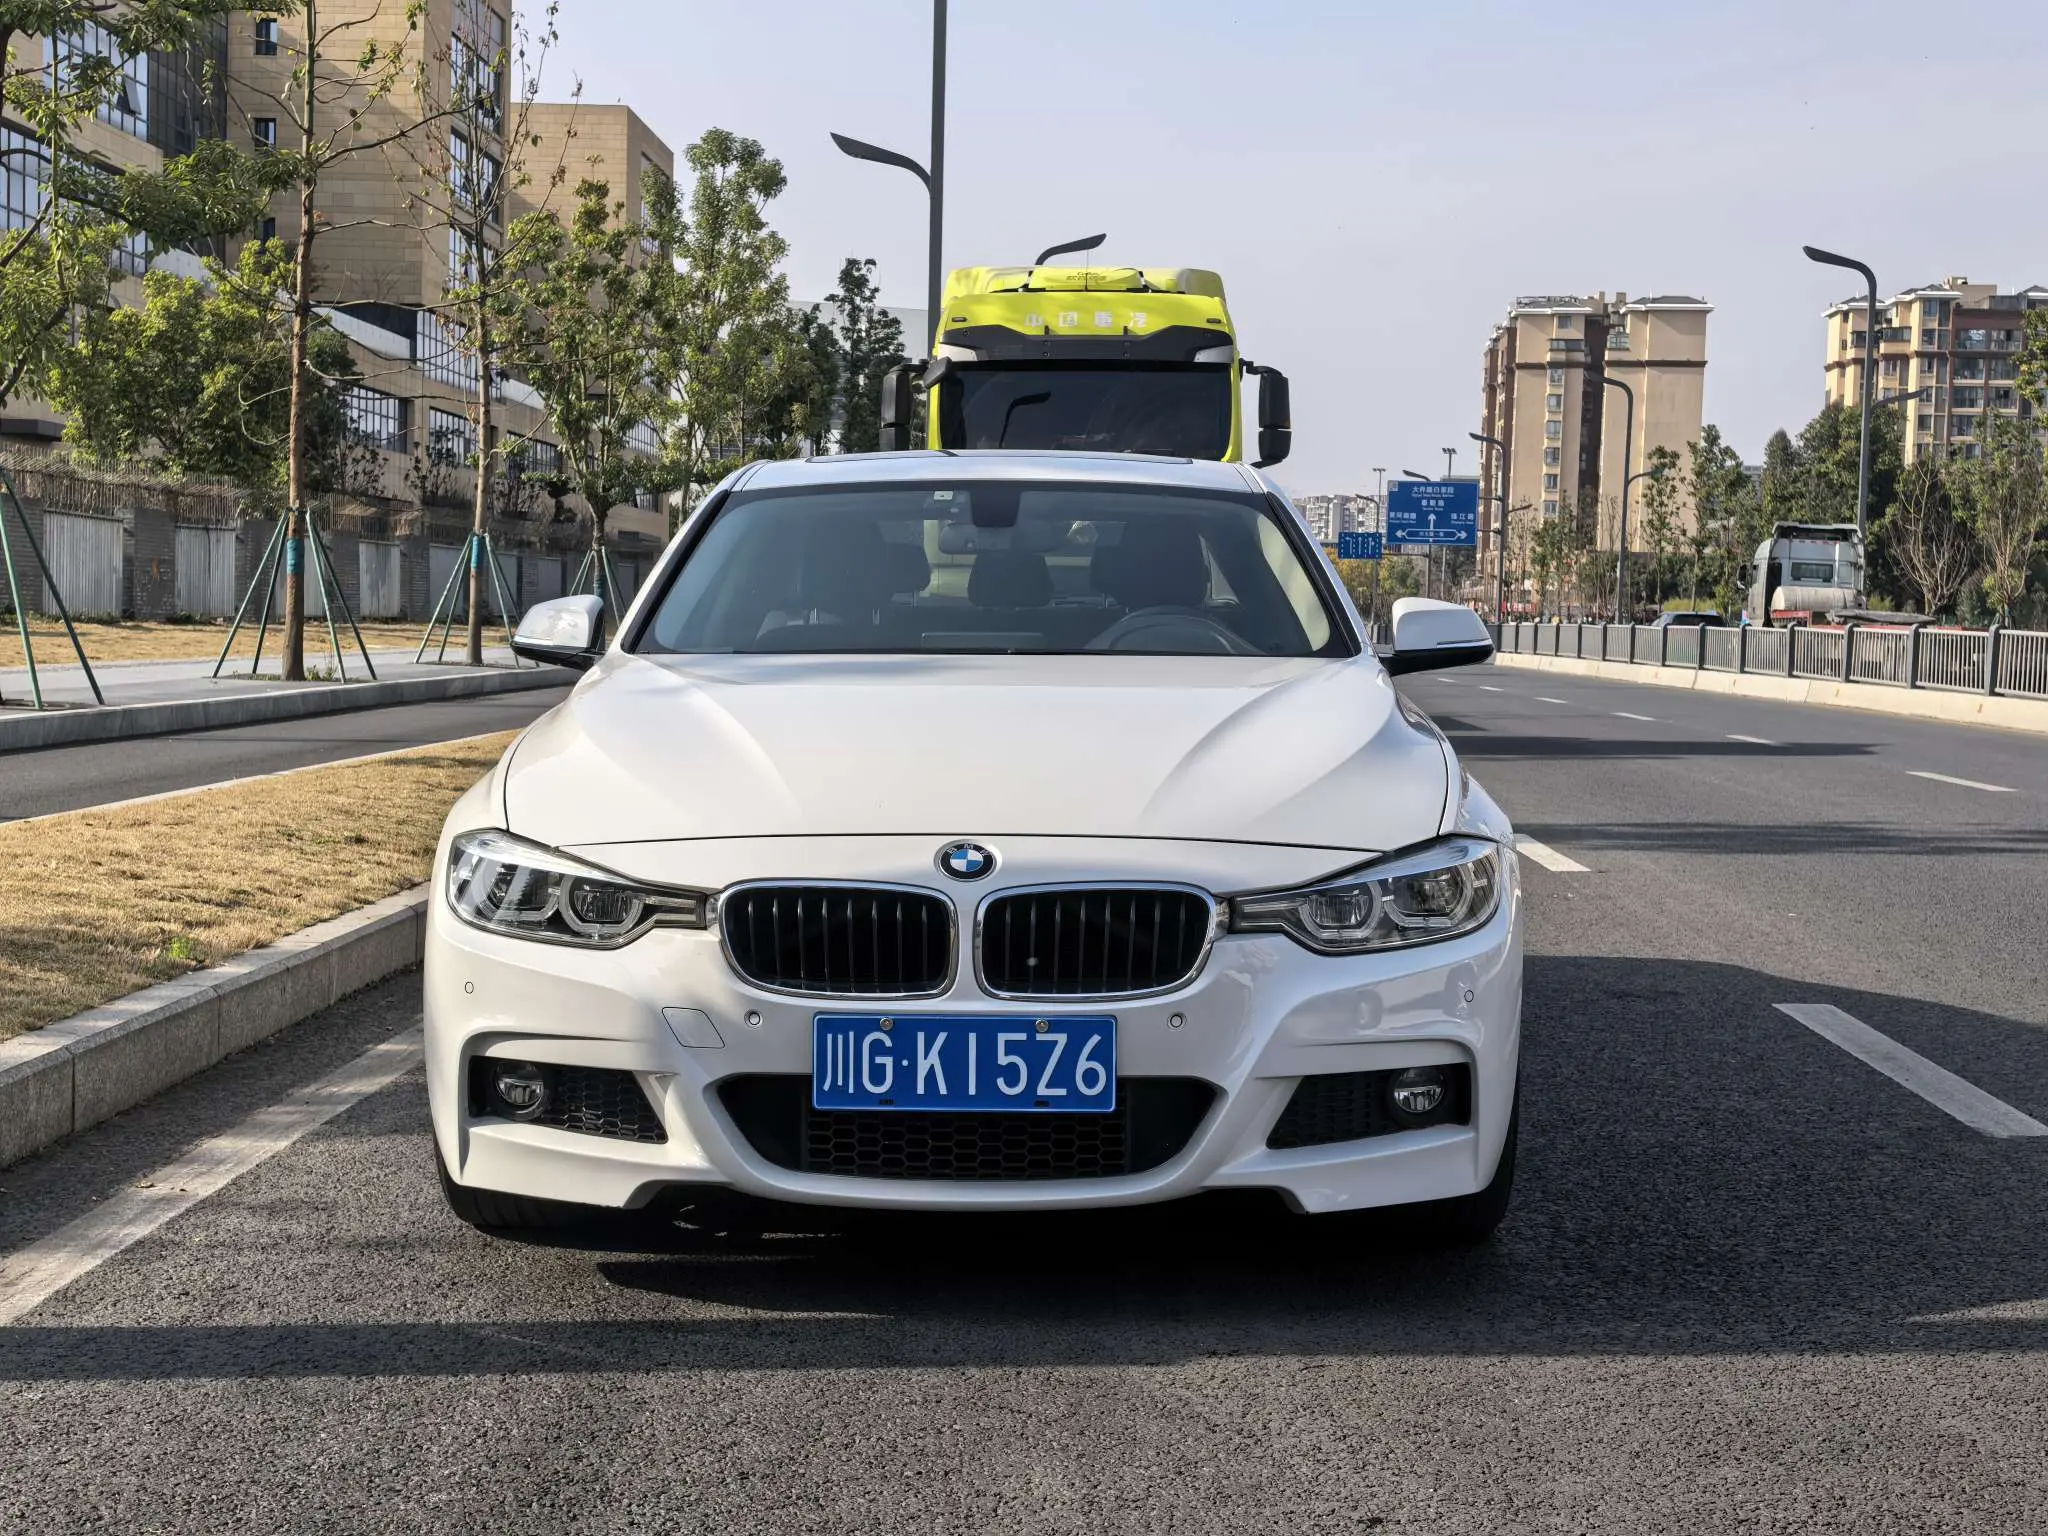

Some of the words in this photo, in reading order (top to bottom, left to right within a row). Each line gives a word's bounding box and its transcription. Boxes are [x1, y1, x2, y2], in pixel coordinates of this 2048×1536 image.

[1025, 311, 1148, 328] 中国重汽
[947, 843, 991, 857] BMW
[823, 1031, 1107, 1096] 川G·K15Z6
